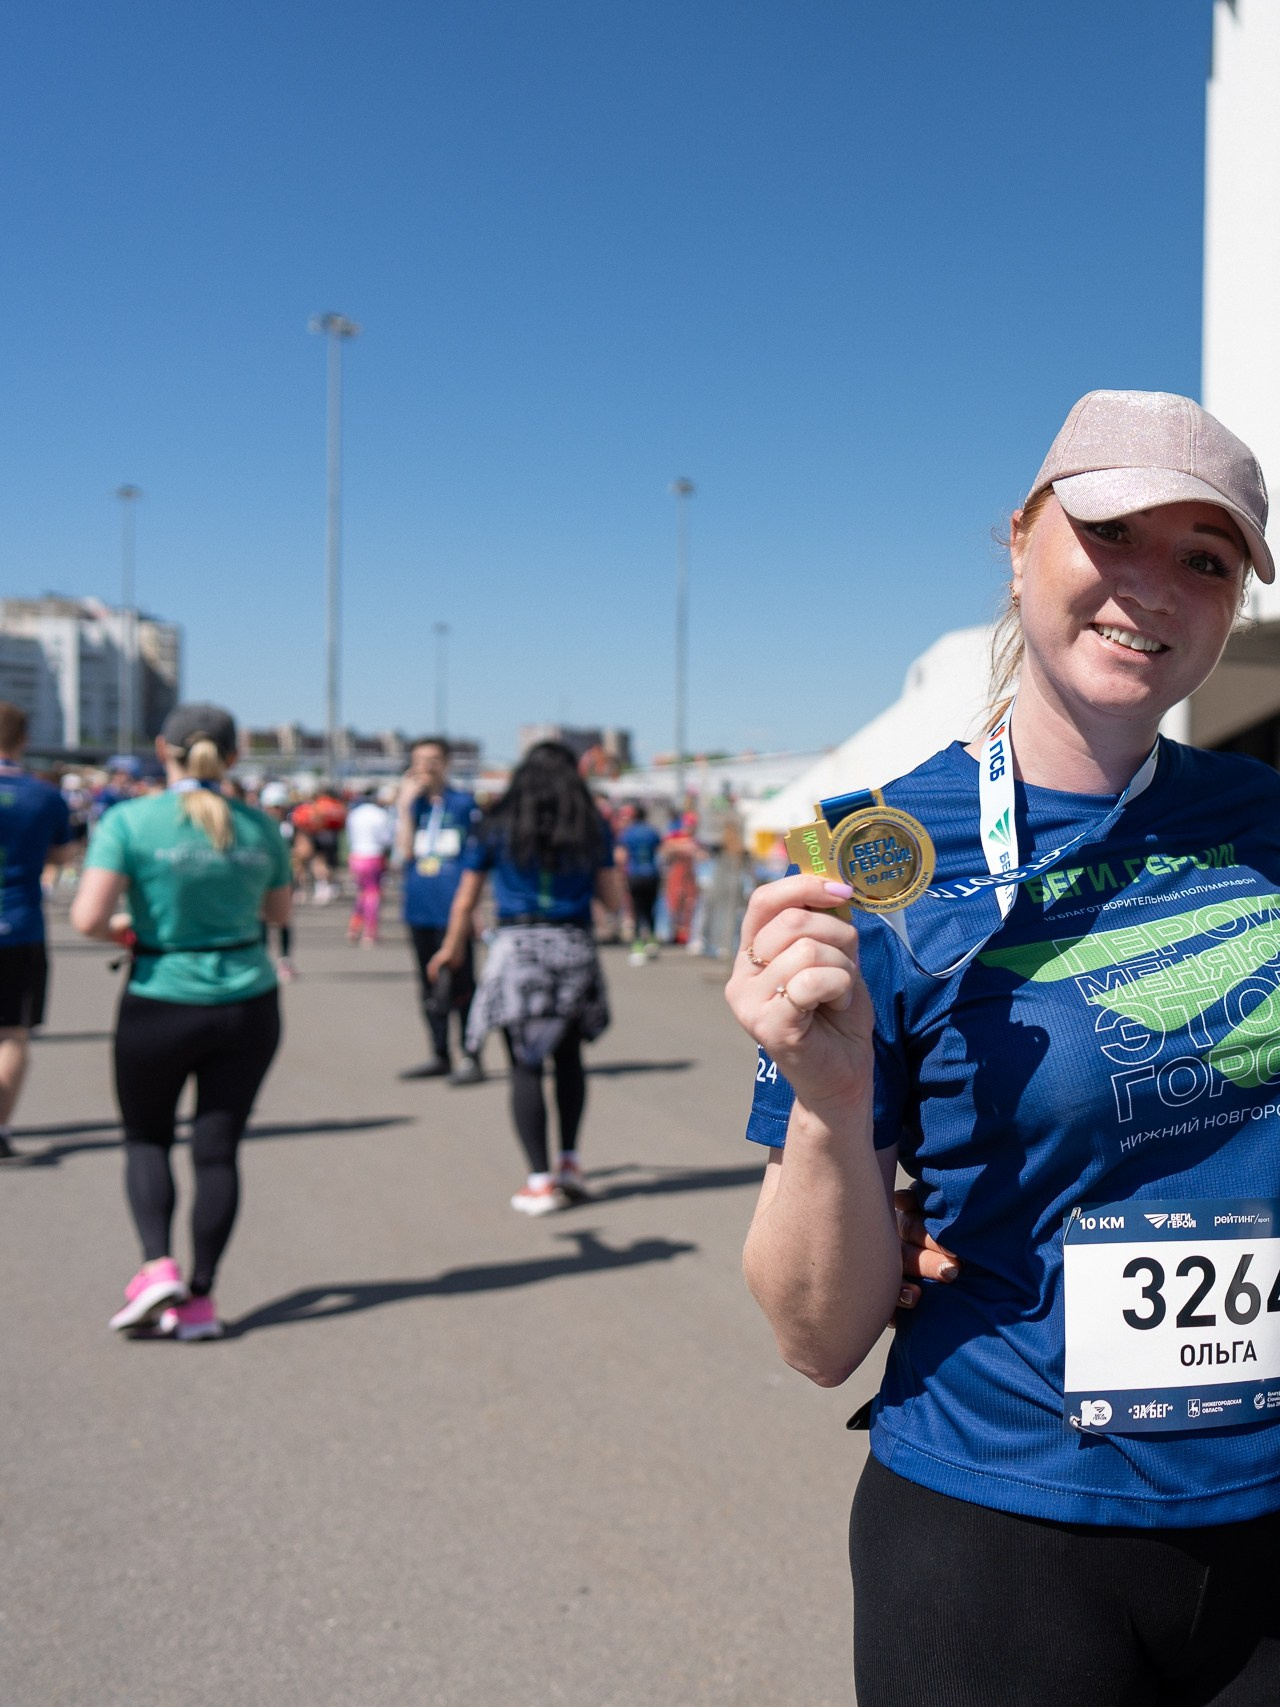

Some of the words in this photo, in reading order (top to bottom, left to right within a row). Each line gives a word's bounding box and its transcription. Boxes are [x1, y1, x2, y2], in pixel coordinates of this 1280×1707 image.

[989, 740, 1006, 782] ПСБ
[864, 874, 878, 885] 10
[881, 867, 904, 882] ЛЕТ
[1057, 890, 1180, 920] БЛАГОТВОРИТЕЛЬНЫЙ
[1181, 877, 1256, 898] ПОЛУМАРАФОН
[1119, 1116, 1200, 1153] НИЖНИЙ
[1080, 1217, 1096, 1230] 10
[1099, 1216, 1125, 1230] КМ
[1179, 1340, 1258, 1368] ОЛЬГА
